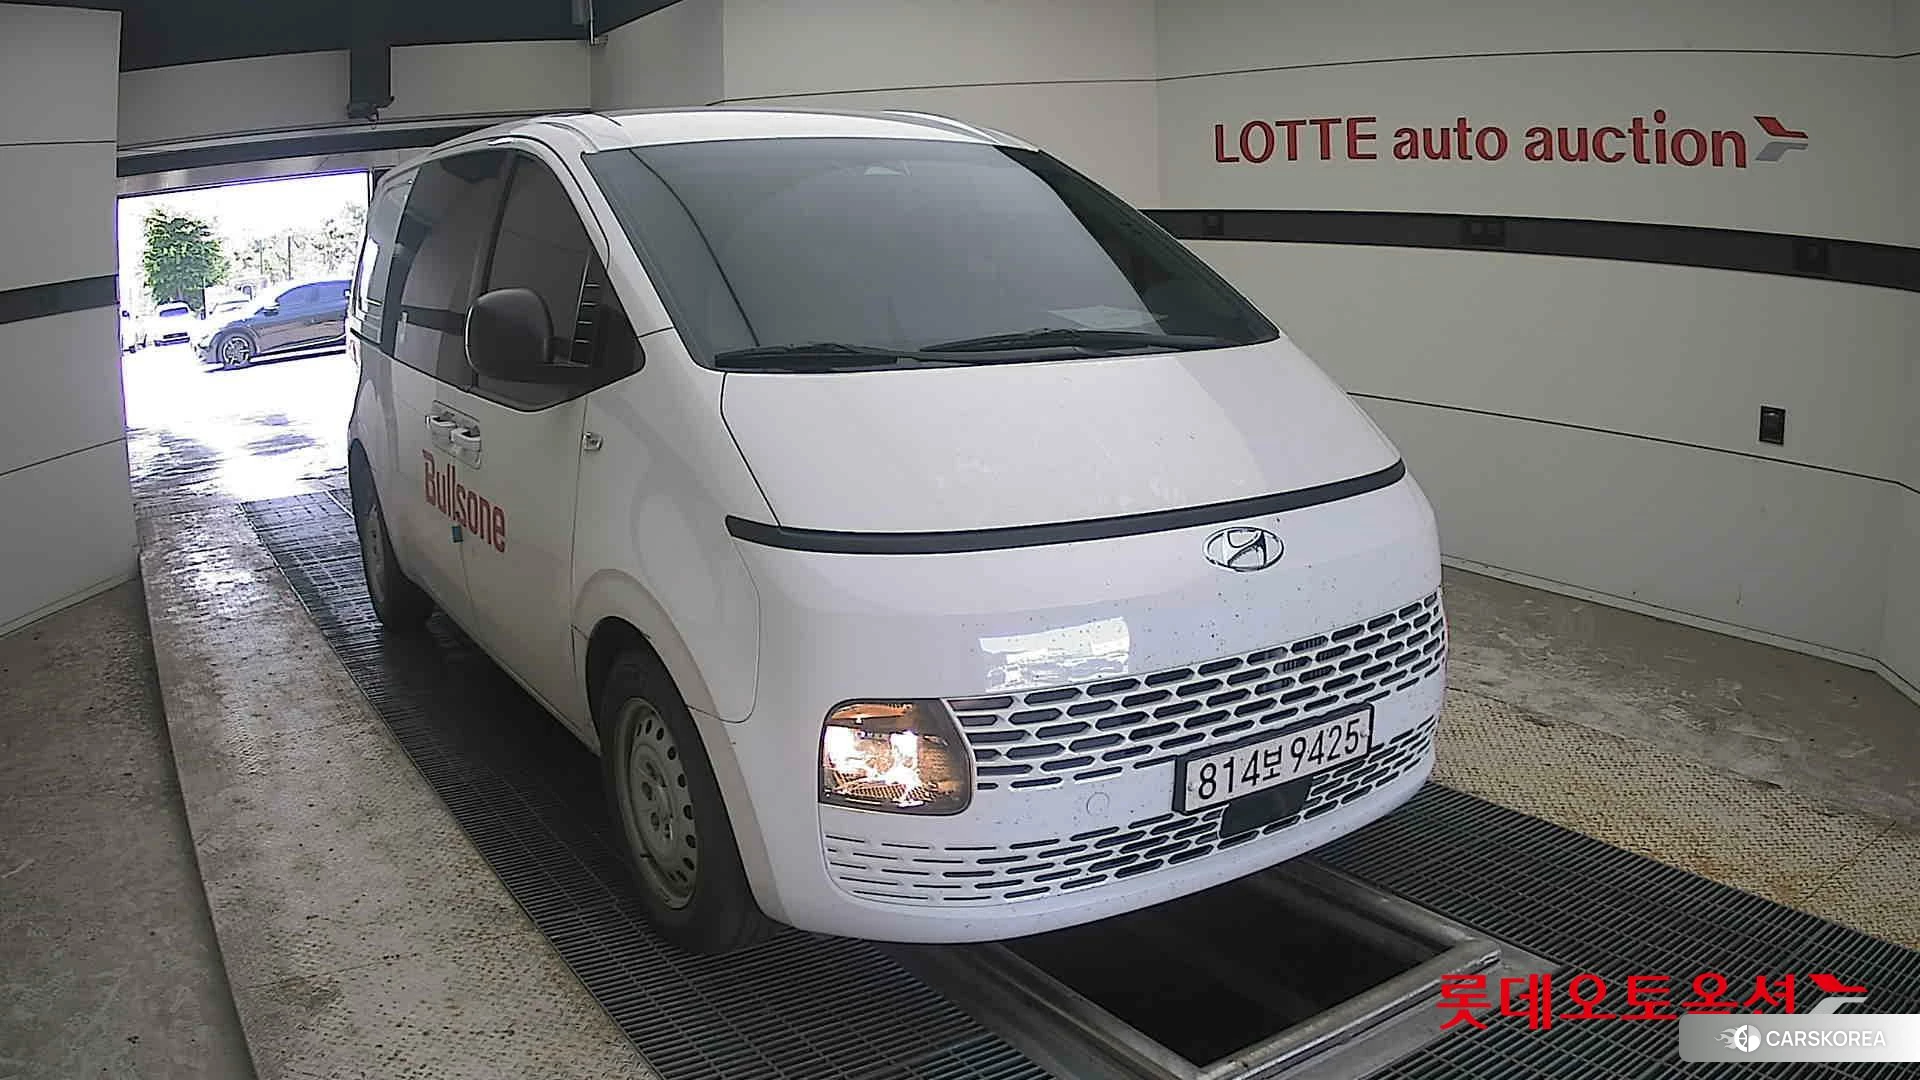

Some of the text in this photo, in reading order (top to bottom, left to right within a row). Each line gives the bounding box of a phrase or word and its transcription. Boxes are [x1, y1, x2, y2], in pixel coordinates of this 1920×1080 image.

[1214, 109, 1747, 168] LOTTE auto auction
[422, 450, 506, 553] Bullsone
